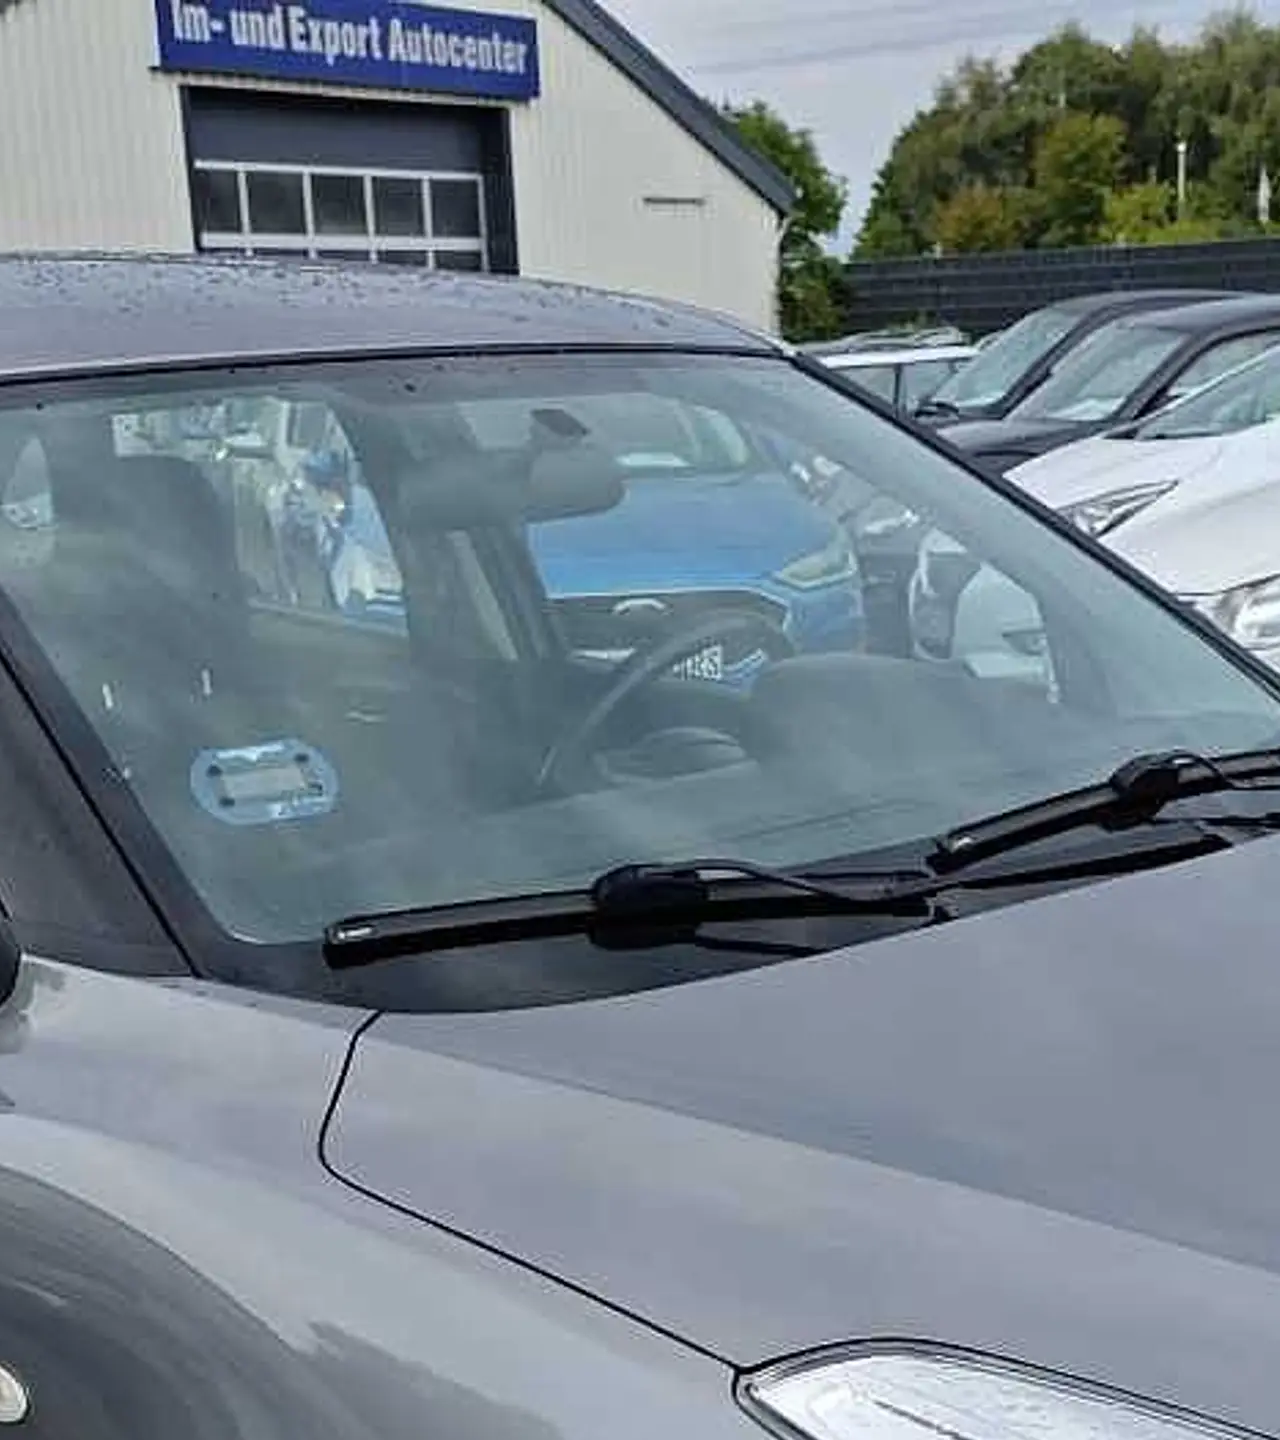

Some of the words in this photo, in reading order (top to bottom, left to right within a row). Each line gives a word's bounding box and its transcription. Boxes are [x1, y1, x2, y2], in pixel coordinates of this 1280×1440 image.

[171, 0, 226, 44] Im-
[229, 3, 286, 50] und
[287, 5, 383, 67] Export
[388, 17, 528, 75] Autocenter
